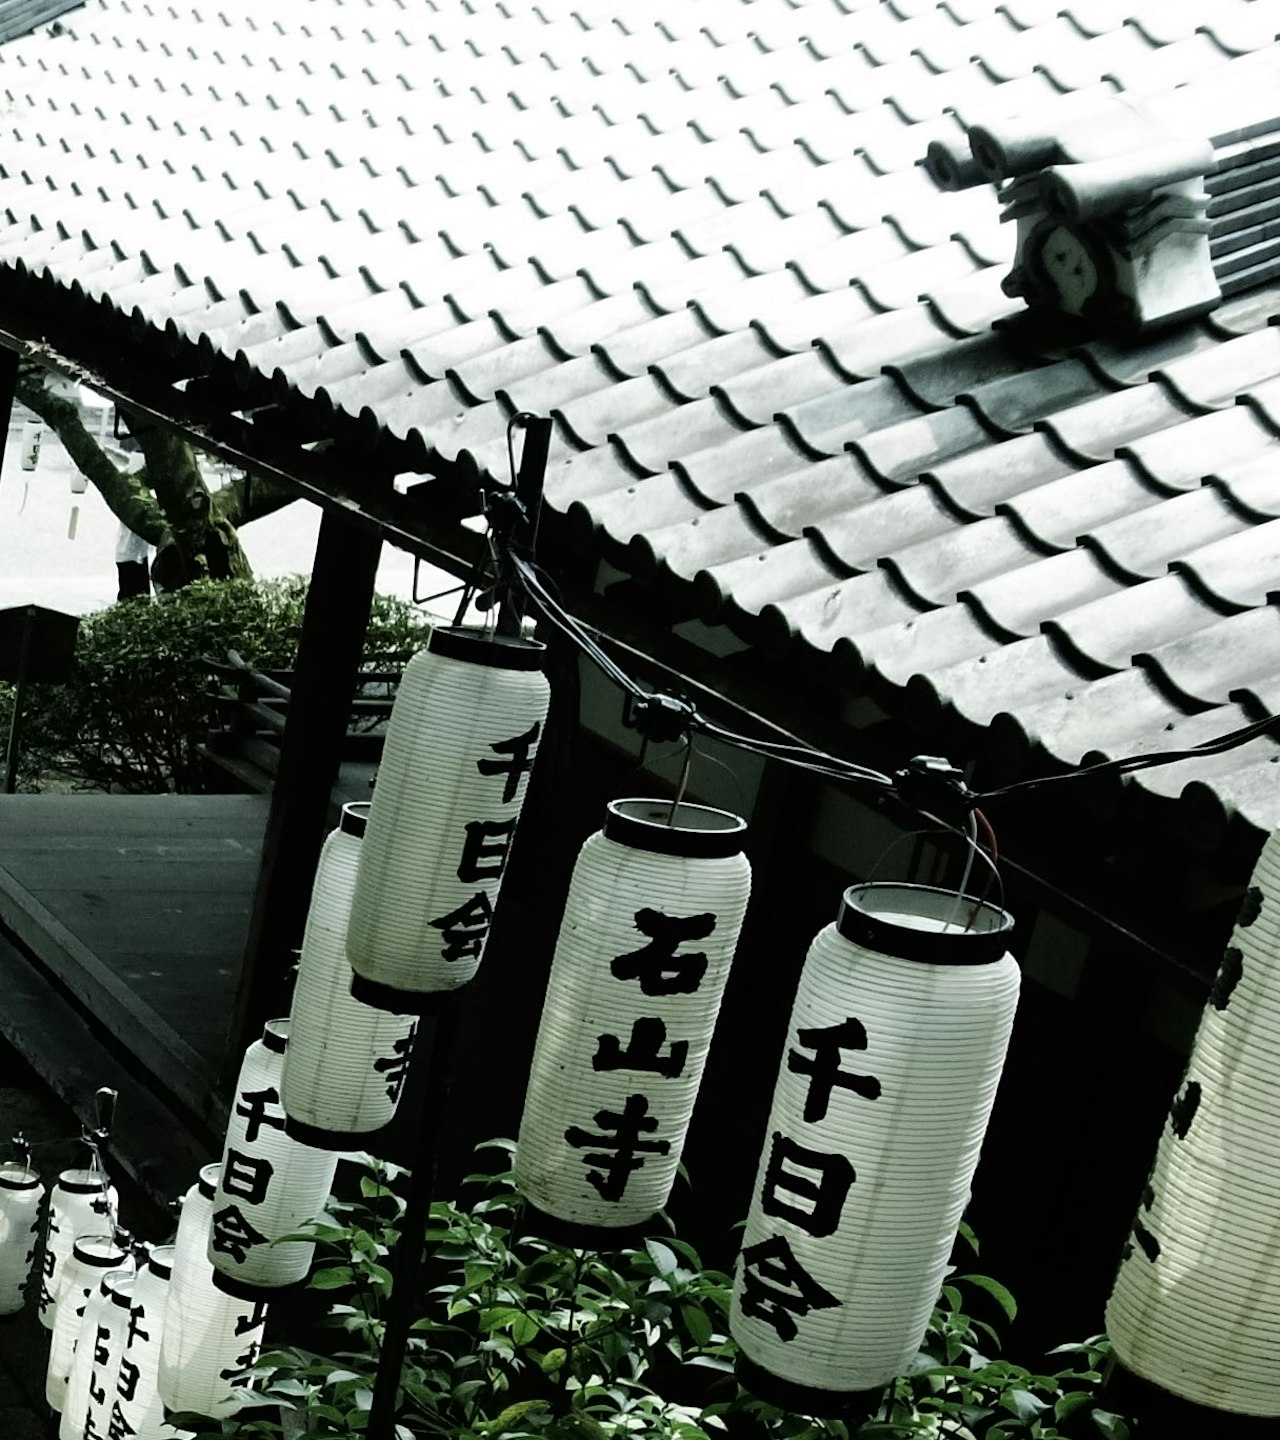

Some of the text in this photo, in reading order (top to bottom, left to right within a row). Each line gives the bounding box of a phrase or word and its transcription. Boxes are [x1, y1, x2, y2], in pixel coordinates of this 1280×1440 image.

[428, 722, 540, 961] 千日会
[213, 1088, 285, 1263] 千日会
[564, 907, 716, 1202] 石山寺
[739, 1015, 882, 1341] 千日会
